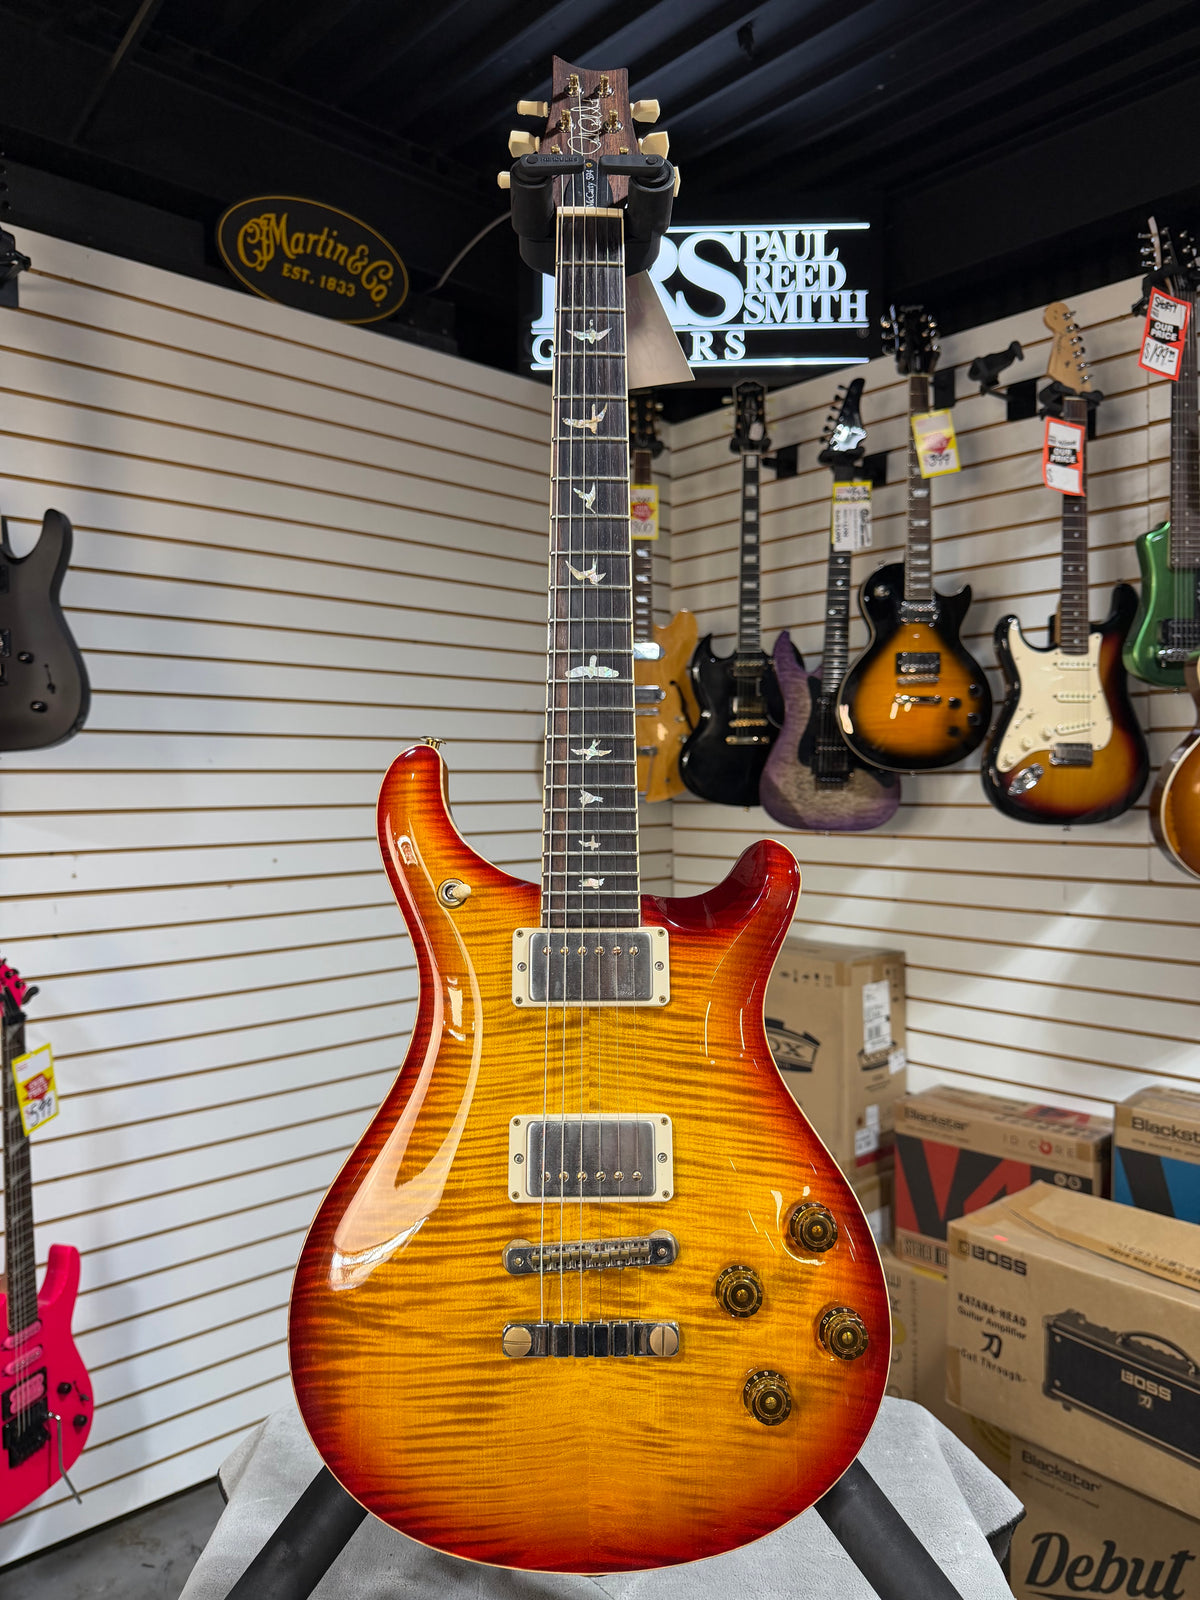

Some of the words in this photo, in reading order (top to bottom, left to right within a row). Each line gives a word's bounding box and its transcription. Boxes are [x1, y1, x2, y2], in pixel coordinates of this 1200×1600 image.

[743, 229, 840, 263] PAUL
[281, 263, 315, 285] EST.
[320, 275, 356, 298] 1833
[743, 261, 848, 294] REED
[743, 289, 870, 324] SMITH
[1150, 328, 1178, 341] PRICE
[1154, 321, 1174, 333] OUR
[903, 1106, 970, 1132] Blackstar
[971, 1244, 1028, 1277] BOSS
[957, 1292, 1027, 1328] KATANA-HEAD
[957, 1305, 984, 1322] Guitar
[985, 1317, 1027, 1340] Amplifier
[1121, 1368, 1172, 1402] BOSS
[1021, 1450, 1100, 1492] Blackstar
[1024, 1531, 1196, 1600] Debut
